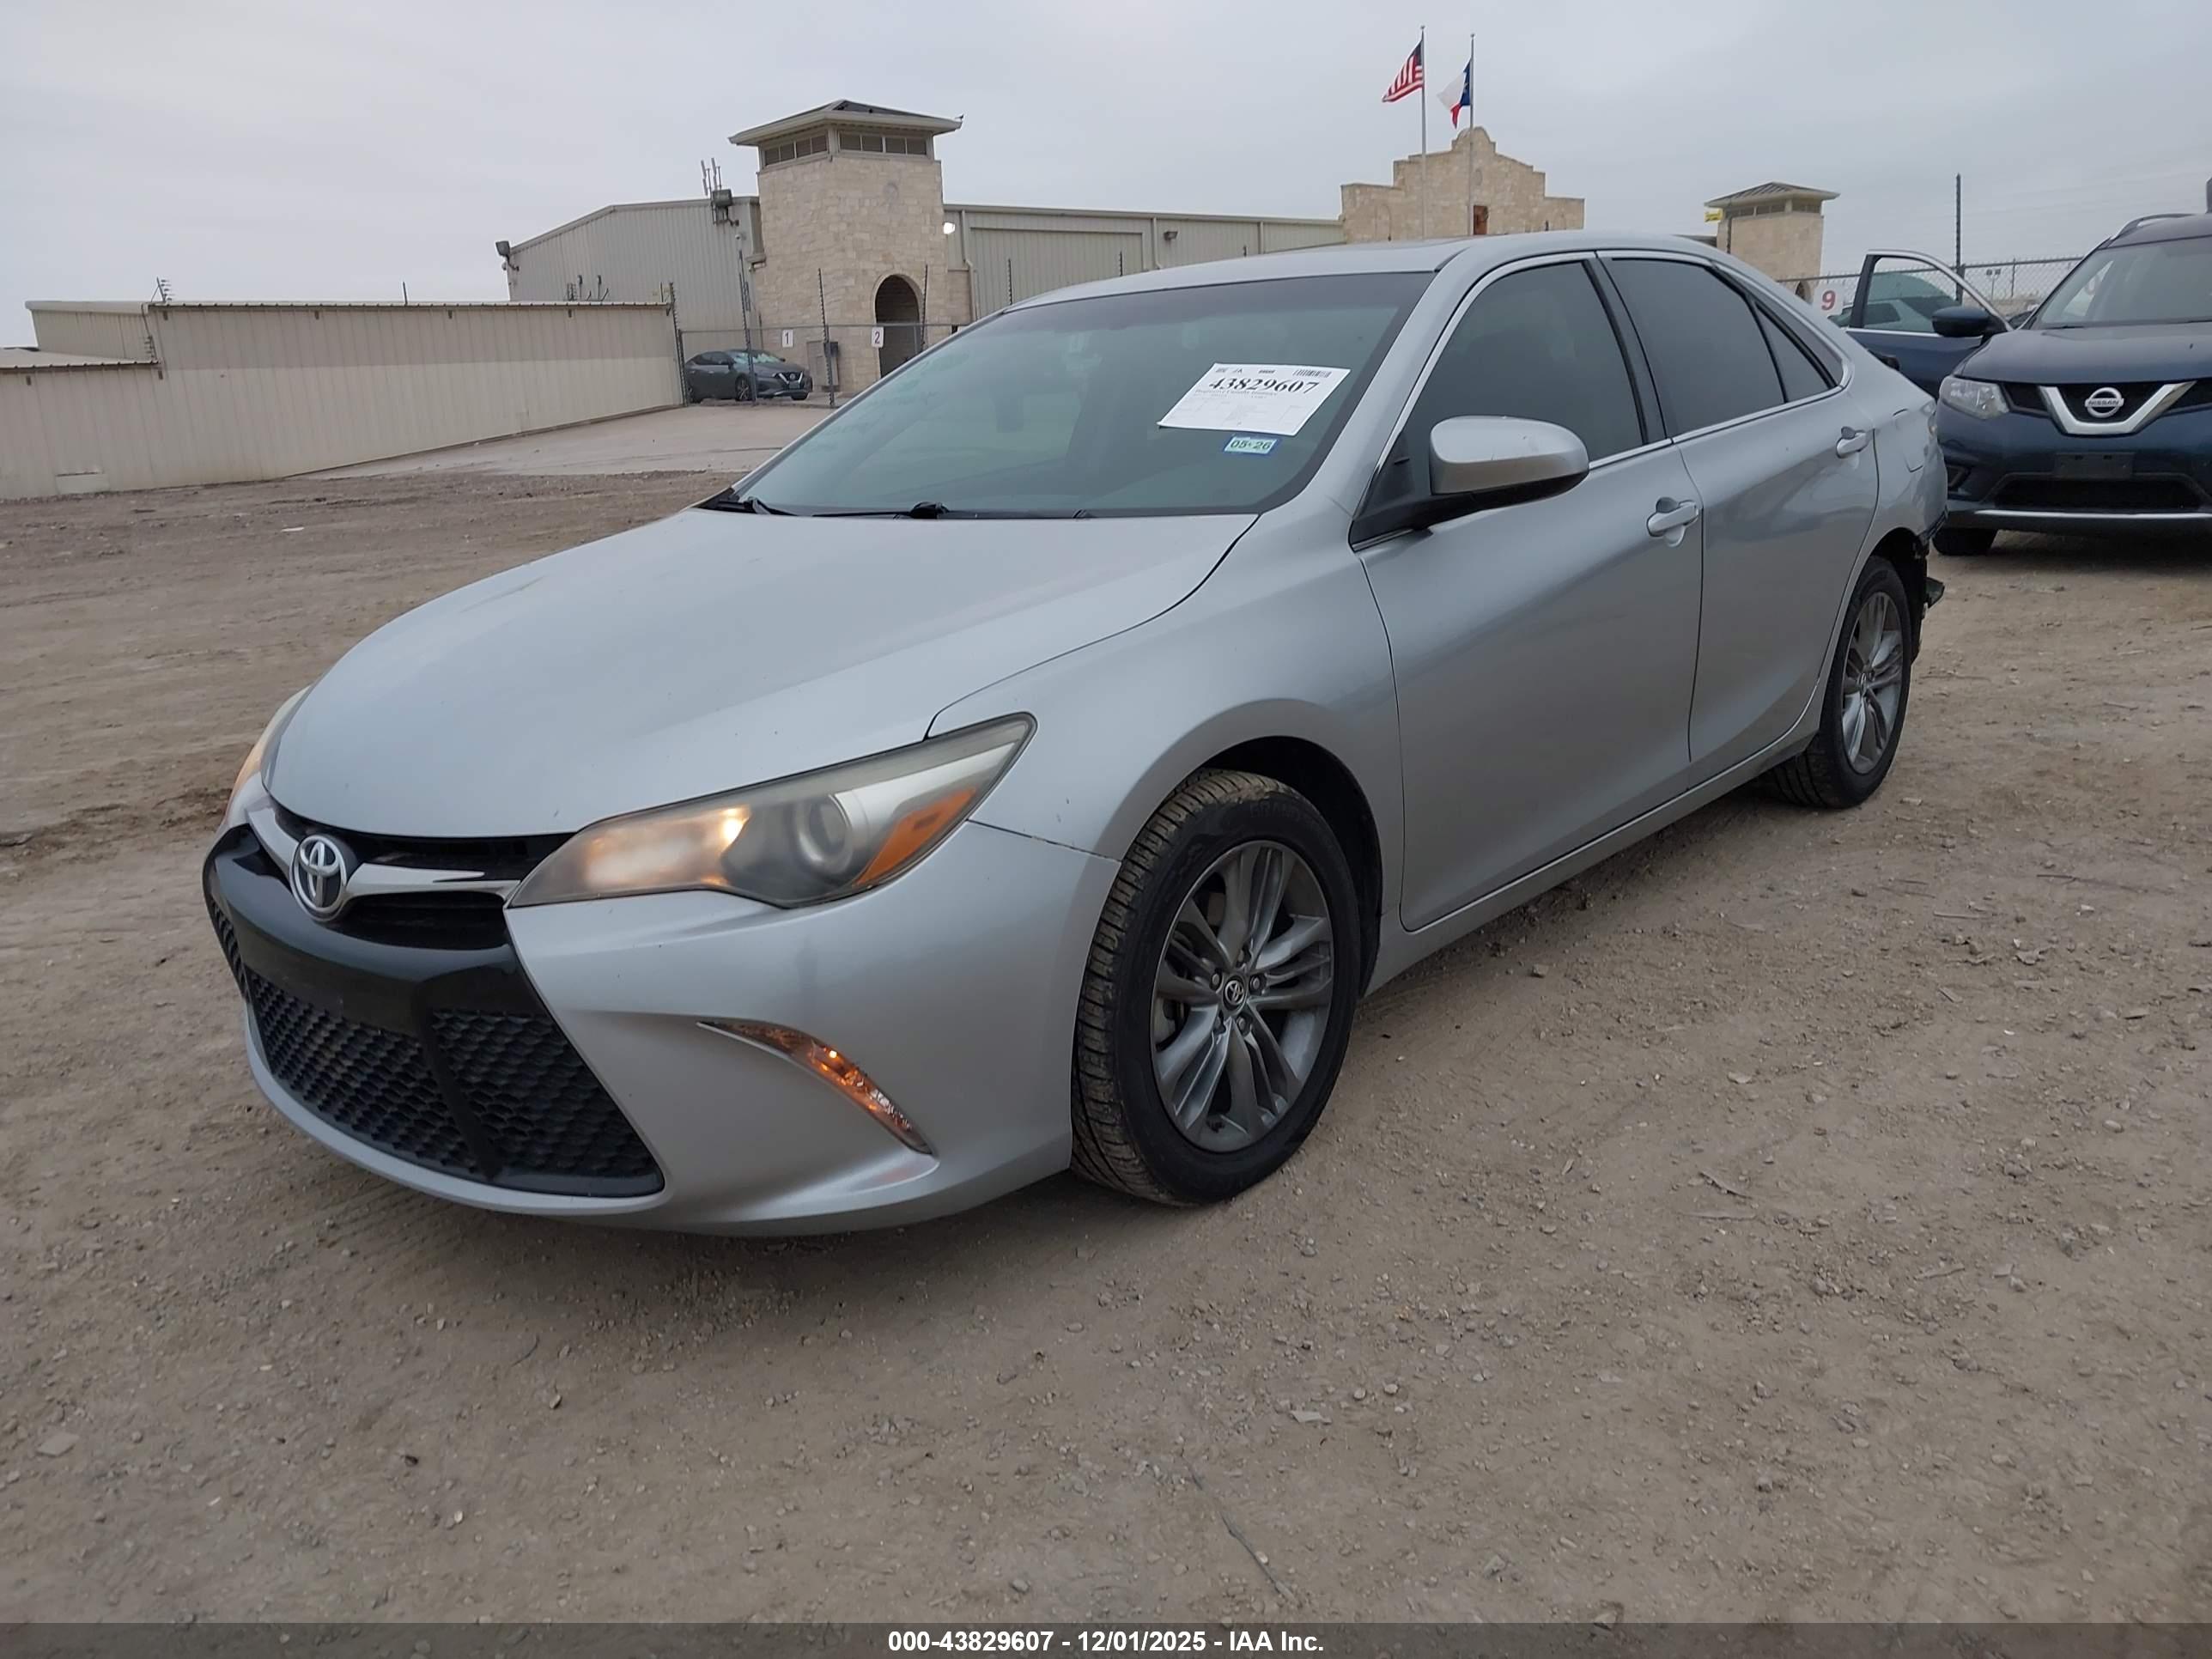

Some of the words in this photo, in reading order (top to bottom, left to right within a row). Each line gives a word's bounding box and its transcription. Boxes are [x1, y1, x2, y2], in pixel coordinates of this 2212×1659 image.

[1821, 289, 1836, 311] 9
[785, 331, 789, 344] 1
[874, 331, 880, 344] 2
[1209, 377, 1320, 394] 43829607
[2087, 398, 2122, 407] NISSAN
